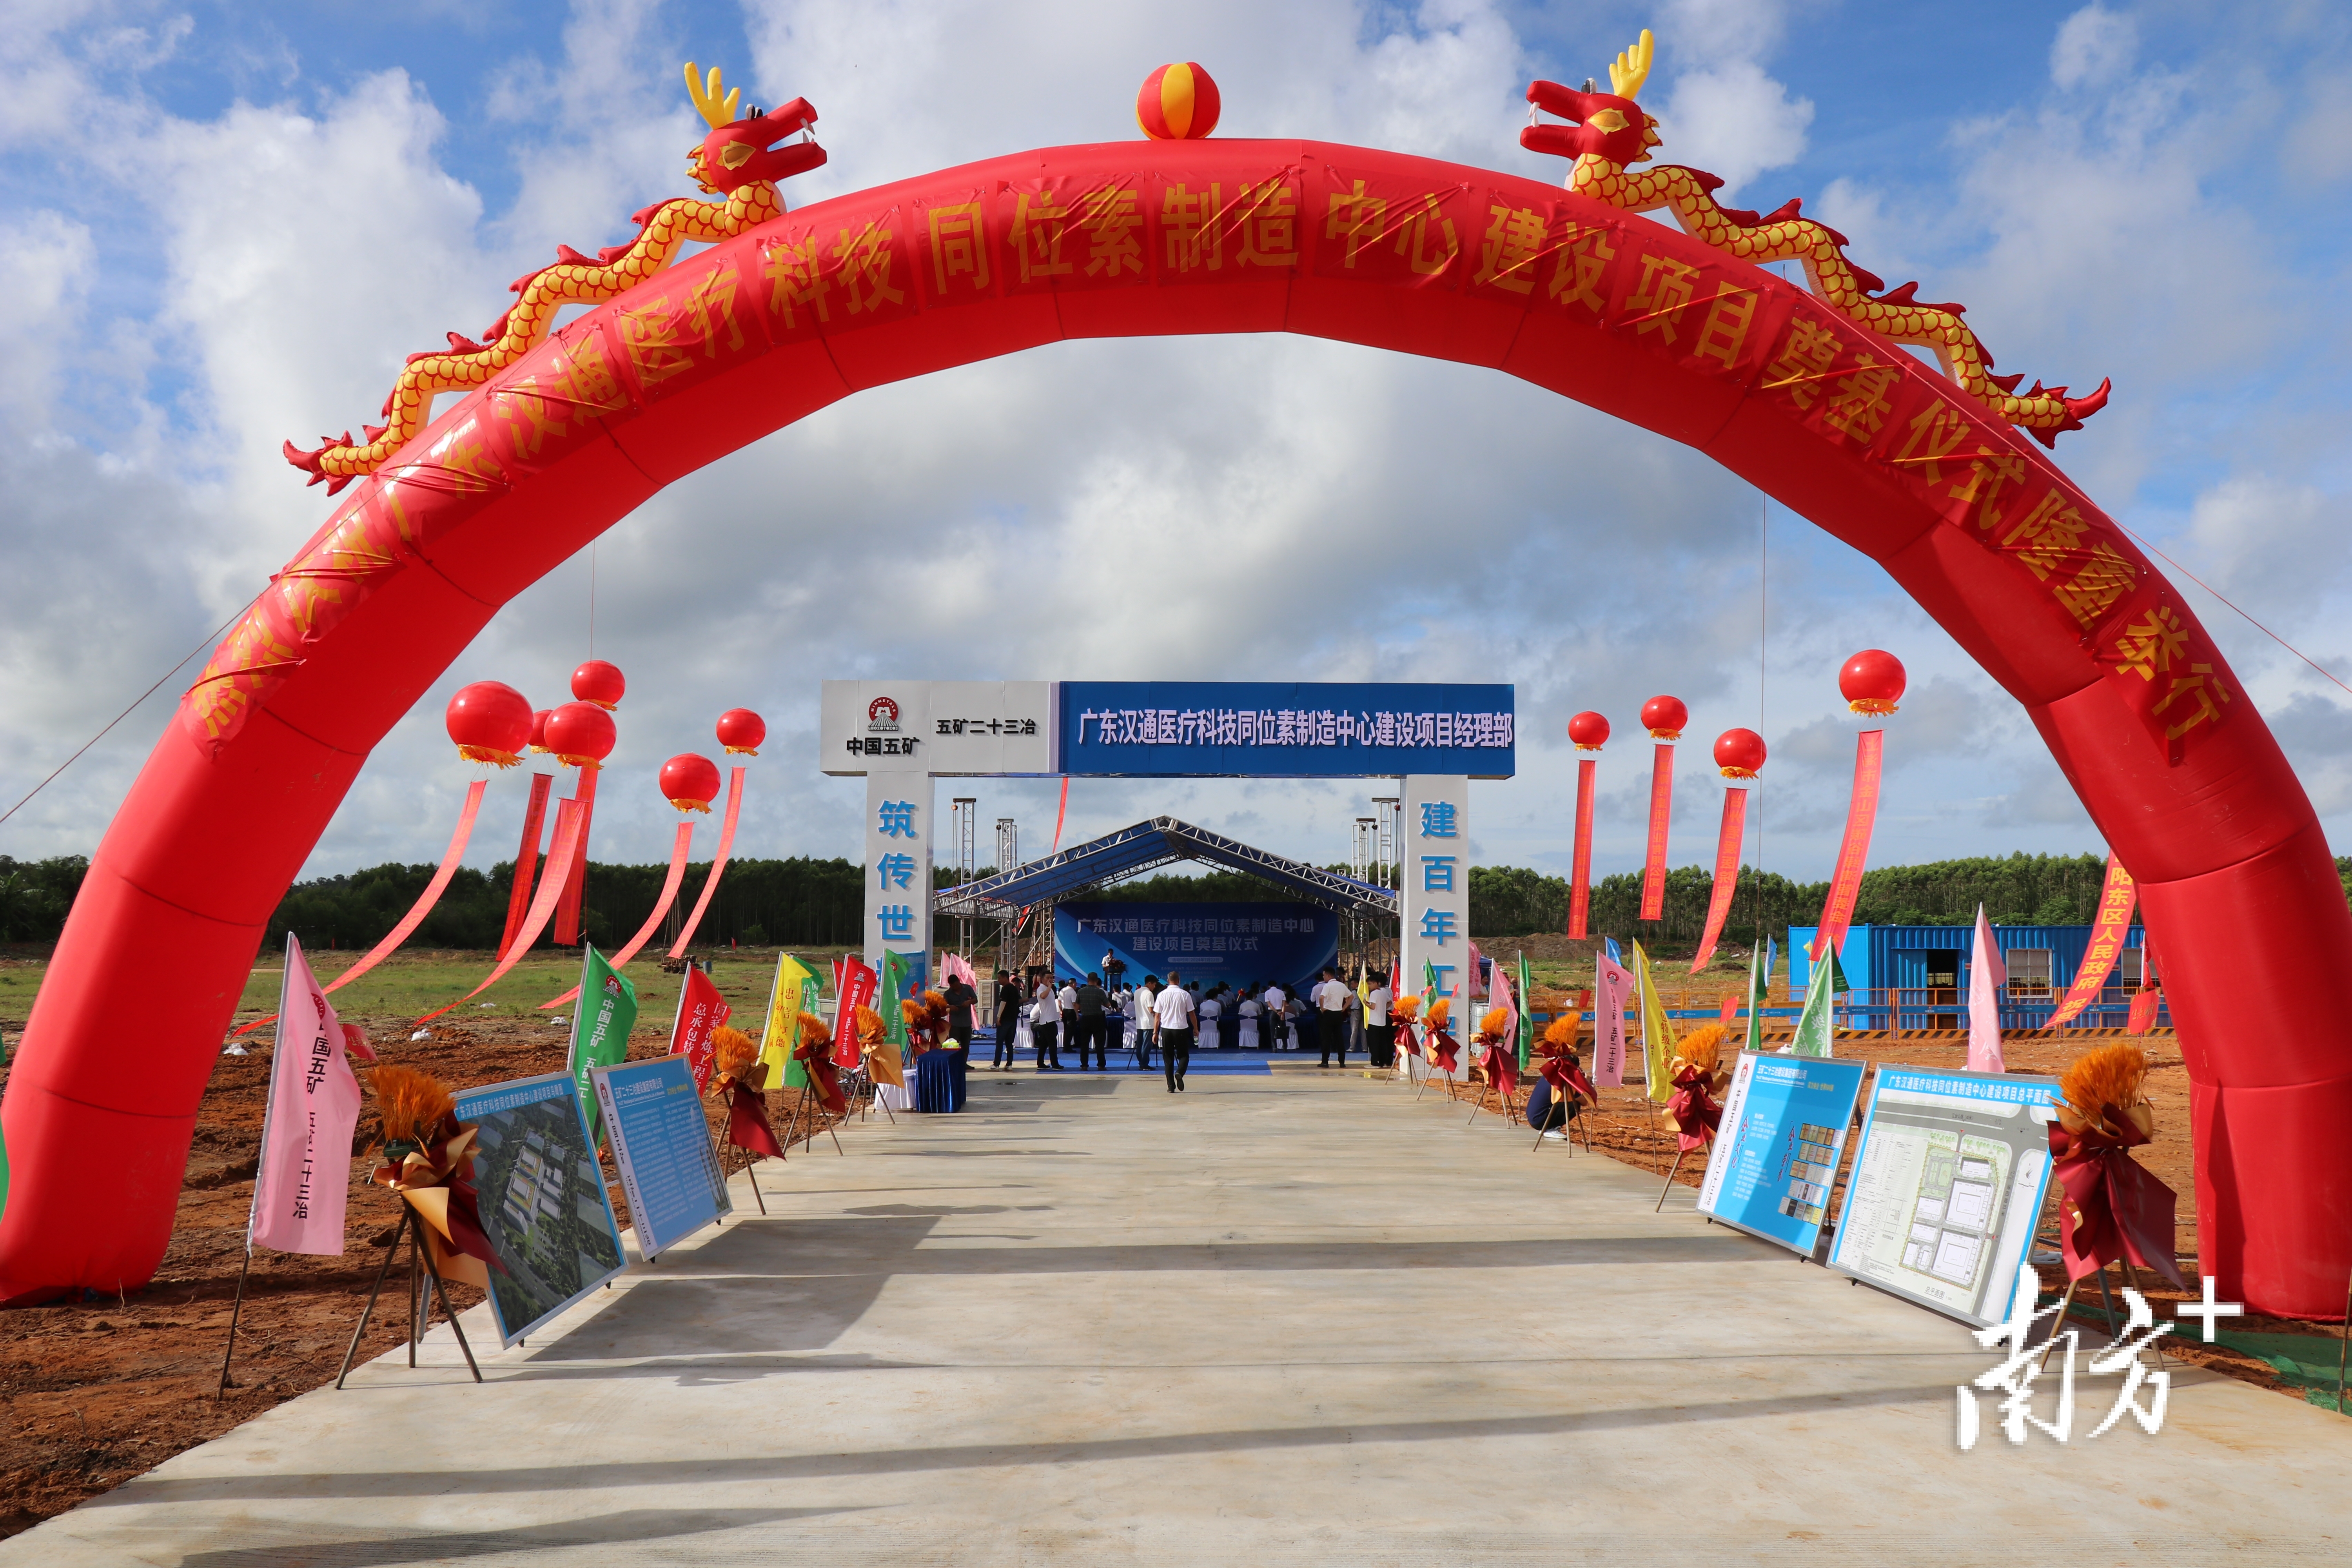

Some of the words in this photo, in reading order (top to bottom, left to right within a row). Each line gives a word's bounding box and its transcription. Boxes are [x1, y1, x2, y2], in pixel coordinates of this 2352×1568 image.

[871, 699, 896, 712] MINMETALS
[936, 719, 1036, 735] 五矿二十三冶
[1078, 707, 1513, 748] 广东汉通医疗科技同位素制造中心建设项目经理部
[847, 737, 919, 755] 中国五矿
[1077, 918, 1314, 933] 广东汉通医疗科技同位素制造中心
[1132, 936, 1258, 951] 建设项目奠基仪式
[848, 984, 861, 1012] 中国五矿
[590, 999, 615, 1047] 中国五矿
[889, 1004, 900, 1040] 五矿二十三冶
[842, 1017, 852, 1056] 五矿二十三冶
[1606, 1027, 1617, 1073] 五矿二十三冶
[1887, 1075, 2052, 1105] 广东汉通医疗科技同位素制造中心建设项目总平面图
[1924, 1286, 1945, 1298] 总平面图
